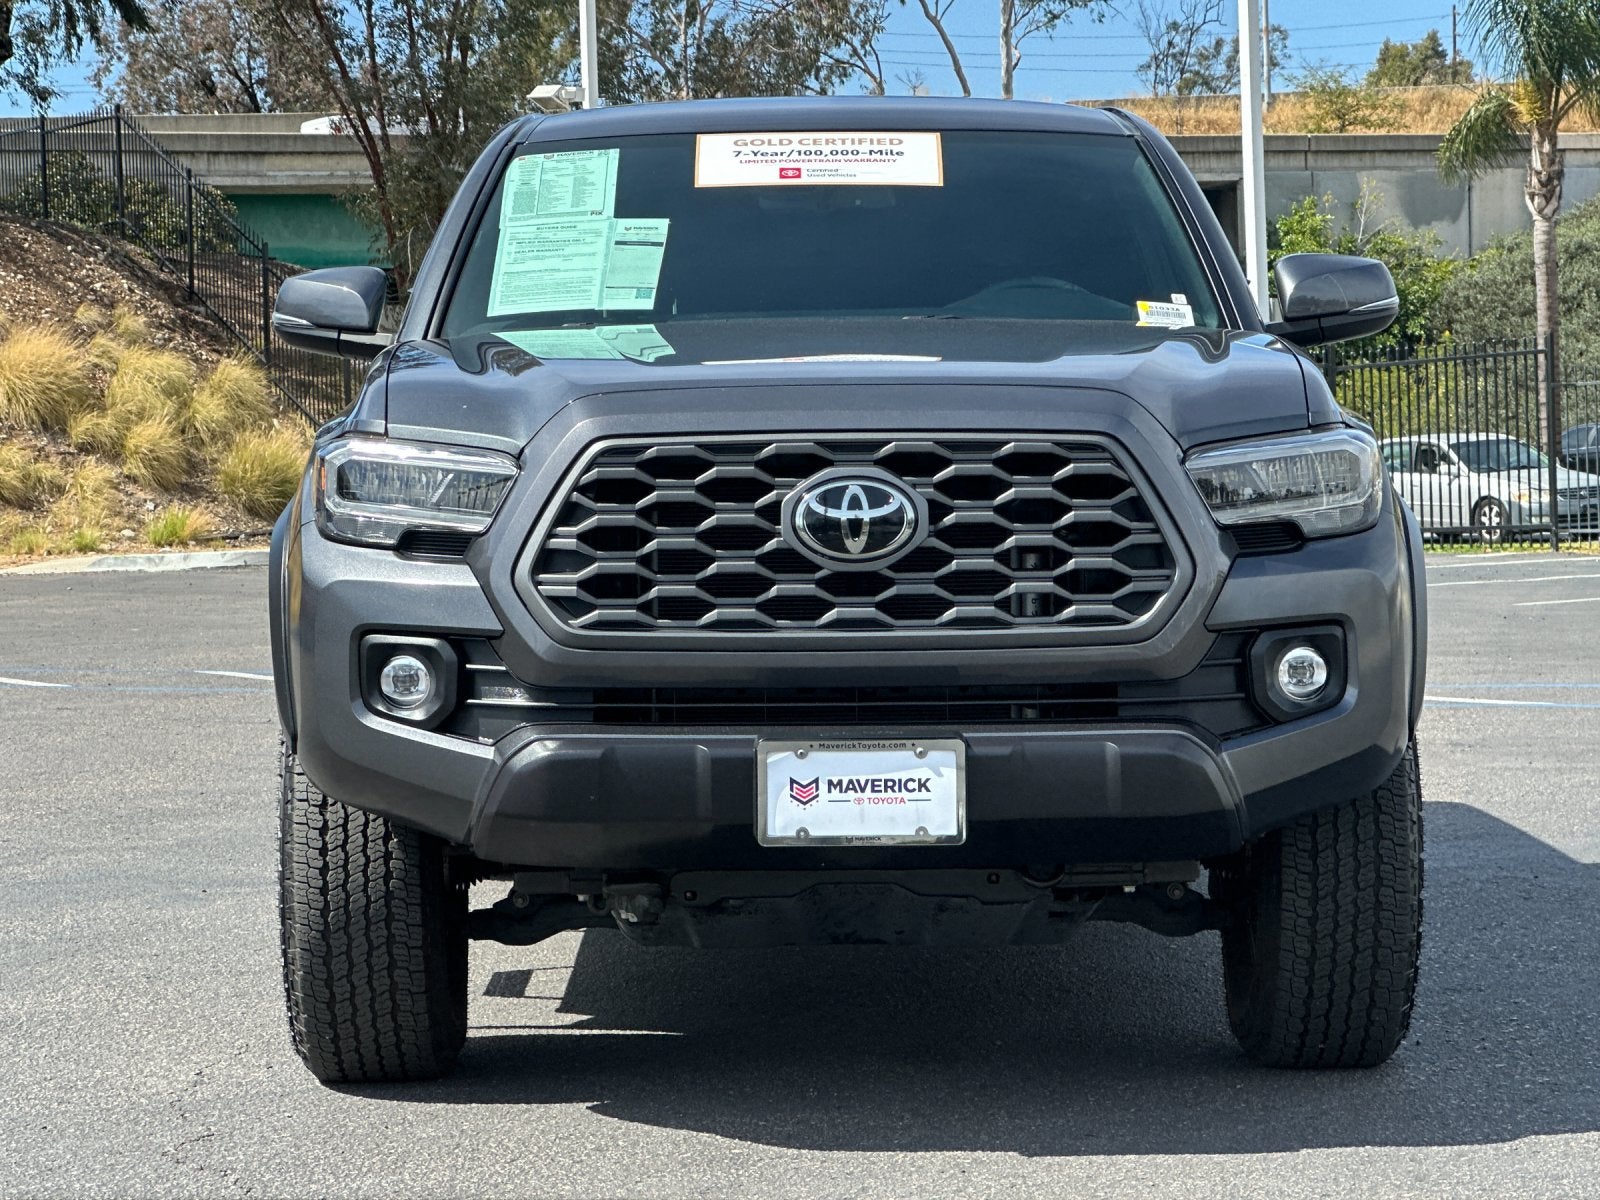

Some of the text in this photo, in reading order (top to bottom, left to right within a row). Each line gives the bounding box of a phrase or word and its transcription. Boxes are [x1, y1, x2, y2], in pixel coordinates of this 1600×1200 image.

[733, 137, 904, 147] GOLD CERTIFIED
[732, 149, 905, 158] 7-Year/100,000-Mile
[827, 778, 931, 793] MAVERICK
